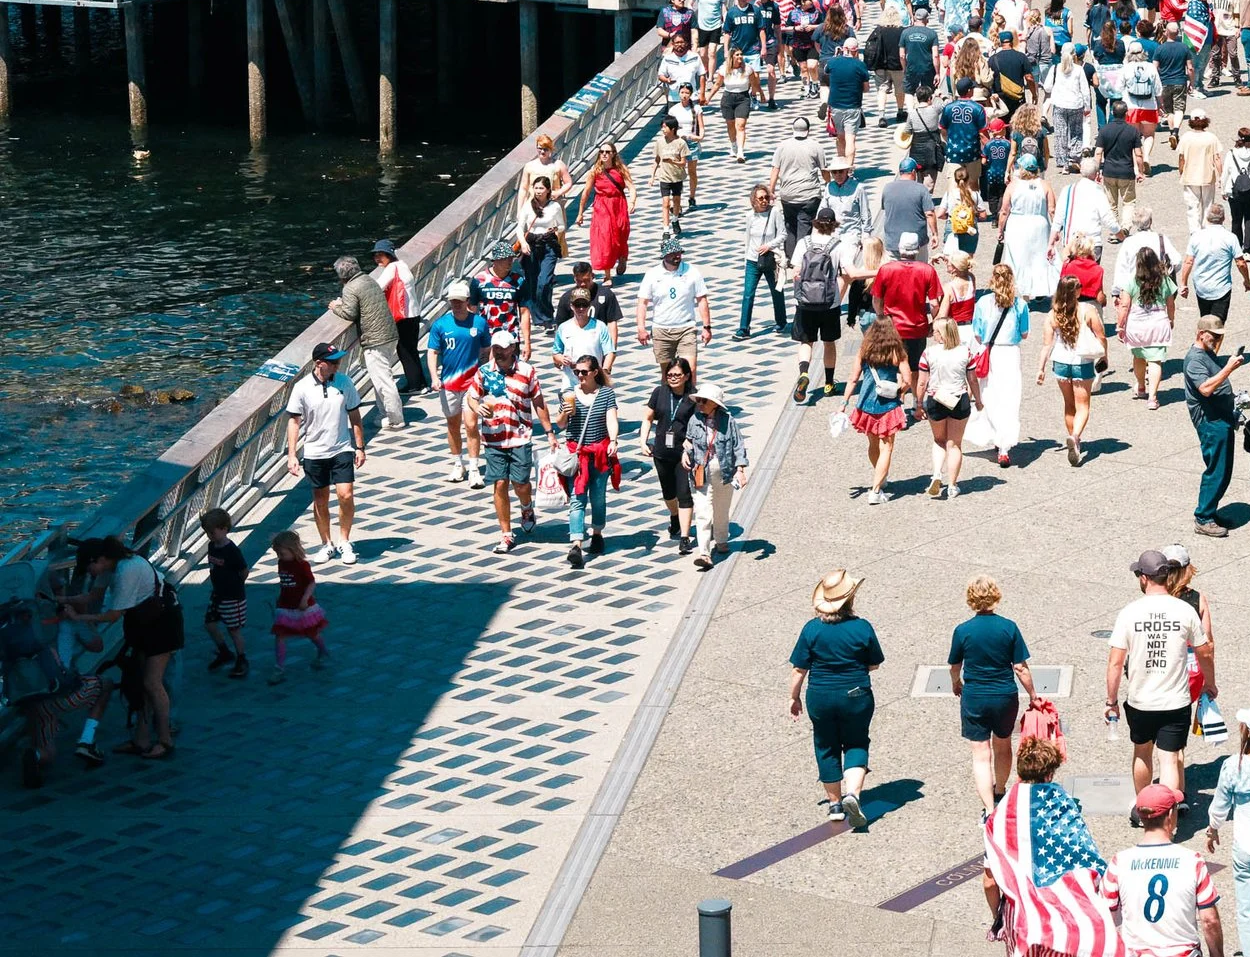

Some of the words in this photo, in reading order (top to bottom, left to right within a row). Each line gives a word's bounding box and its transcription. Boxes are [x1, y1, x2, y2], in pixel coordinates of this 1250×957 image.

[734, 16, 755, 25] USA
[951, 105, 974, 124] 26
[990, 145, 1006, 160] 26
[486, 291, 513, 300] USA
[669, 287, 677, 300] 8
[444, 337, 456, 350] 10
[1149, 612, 1167, 620] THE
[1134, 621, 1181, 632] CROSS
[1147, 640, 1167, 649] NOT
[1147, 649, 1167, 659] THE
[1145, 659, 1167, 669] END
[1130, 857, 1181, 871] McKENNIE
[1143, 873, 1169, 924] 8
